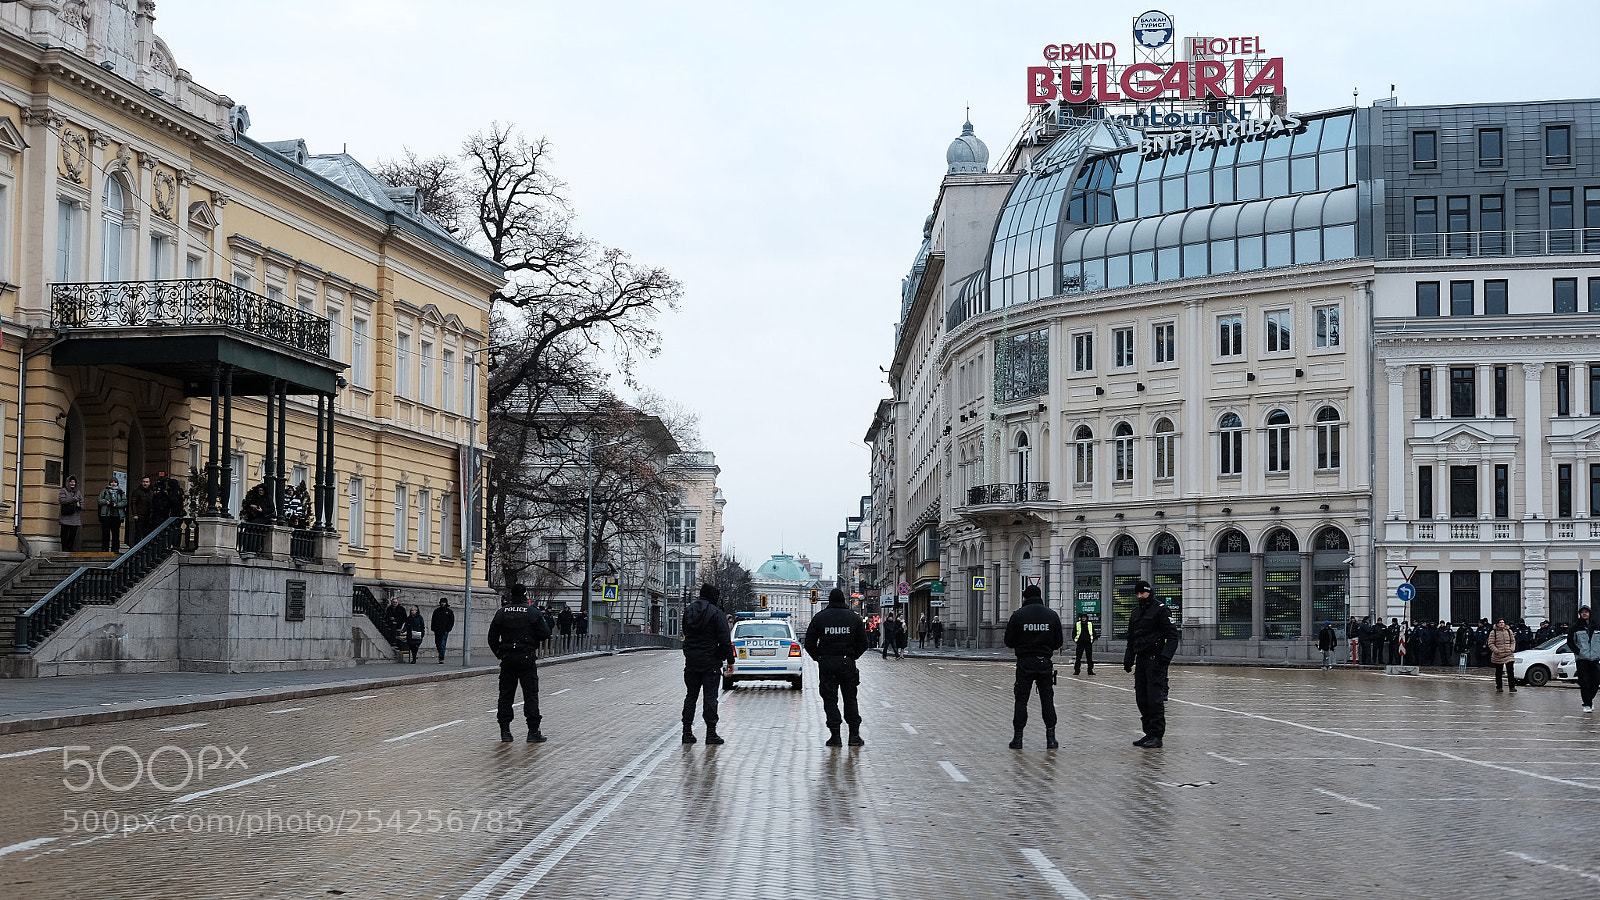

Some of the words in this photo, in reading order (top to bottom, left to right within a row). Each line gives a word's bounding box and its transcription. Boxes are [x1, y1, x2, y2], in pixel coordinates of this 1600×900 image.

[1043, 42, 1117, 61] GRAND
[1192, 36, 1266, 56] HOTEL
[1027, 57, 1284, 104] BULGARIA
[1138, 132, 1187, 156] BNP
[1190, 112, 1301, 146] PARIBAS
[824, 626, 851, 635] POLICE
[1023, 623, 1050, 631] POLICE
